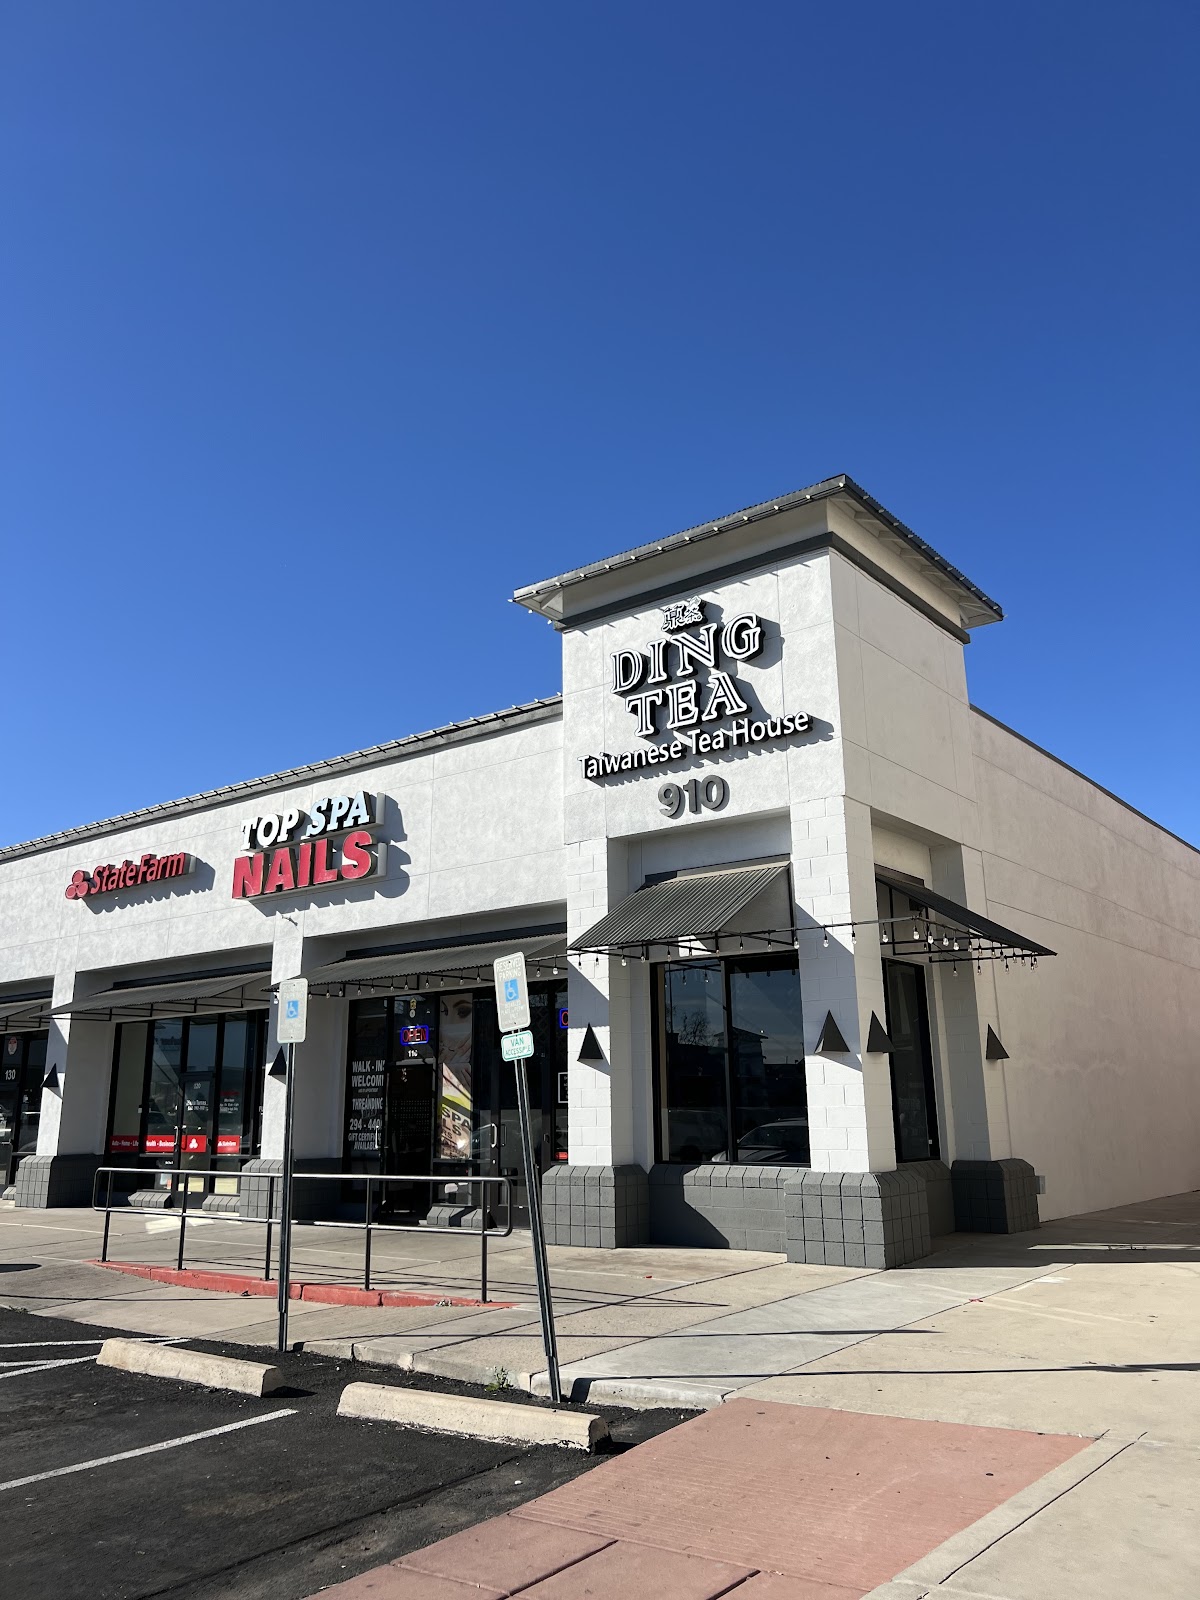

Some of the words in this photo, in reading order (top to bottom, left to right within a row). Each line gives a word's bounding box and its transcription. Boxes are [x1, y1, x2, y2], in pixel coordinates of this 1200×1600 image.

[610, 613, 762, 693] DING
[625, 672, 748, 737] TEA
[578, 740, 682, 779] Taiwanese
[688, 729, 724, 754] Tea
[732, 711, 809, 746] House
[658, 774, 726, 817] 910
[240, 808, 299, 851] TOP
[305, 791, 371, 839] SPA
[231, 831, 374, 899] NAILS
[403, 1028, 427, 1043] OPEN
[510, 1037, 524, 1046] VAN
[5, 1069, 16, 1080] 130
[352, 1060, 371, 1073] WALK
[350, 1118, 362, 1131] 294
